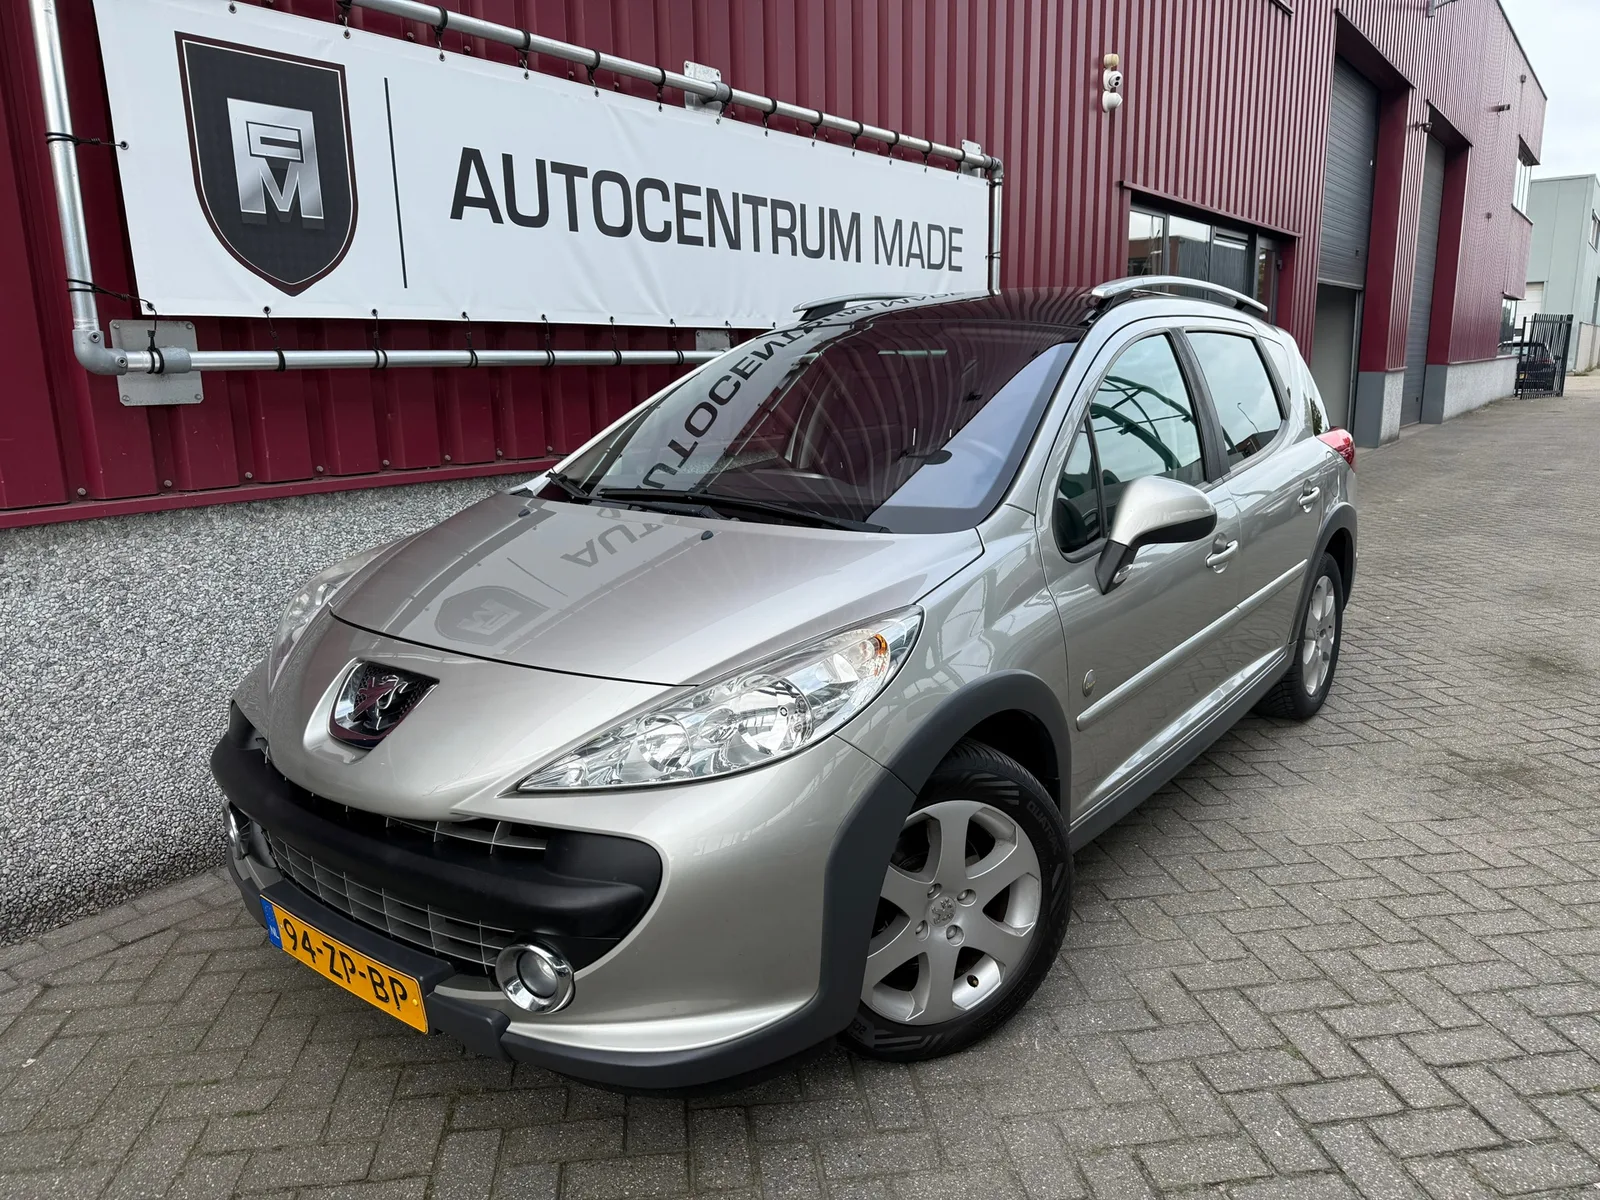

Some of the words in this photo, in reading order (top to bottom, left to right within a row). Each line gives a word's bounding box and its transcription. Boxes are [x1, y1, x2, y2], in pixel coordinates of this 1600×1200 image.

[450, 147, 862, 264] AUTOCENTRUM
[873, 215, 964, 273] MADE
[269, 924, 281, 940] NL
[283, 918, 408, 1011] 94-ZP-BP
